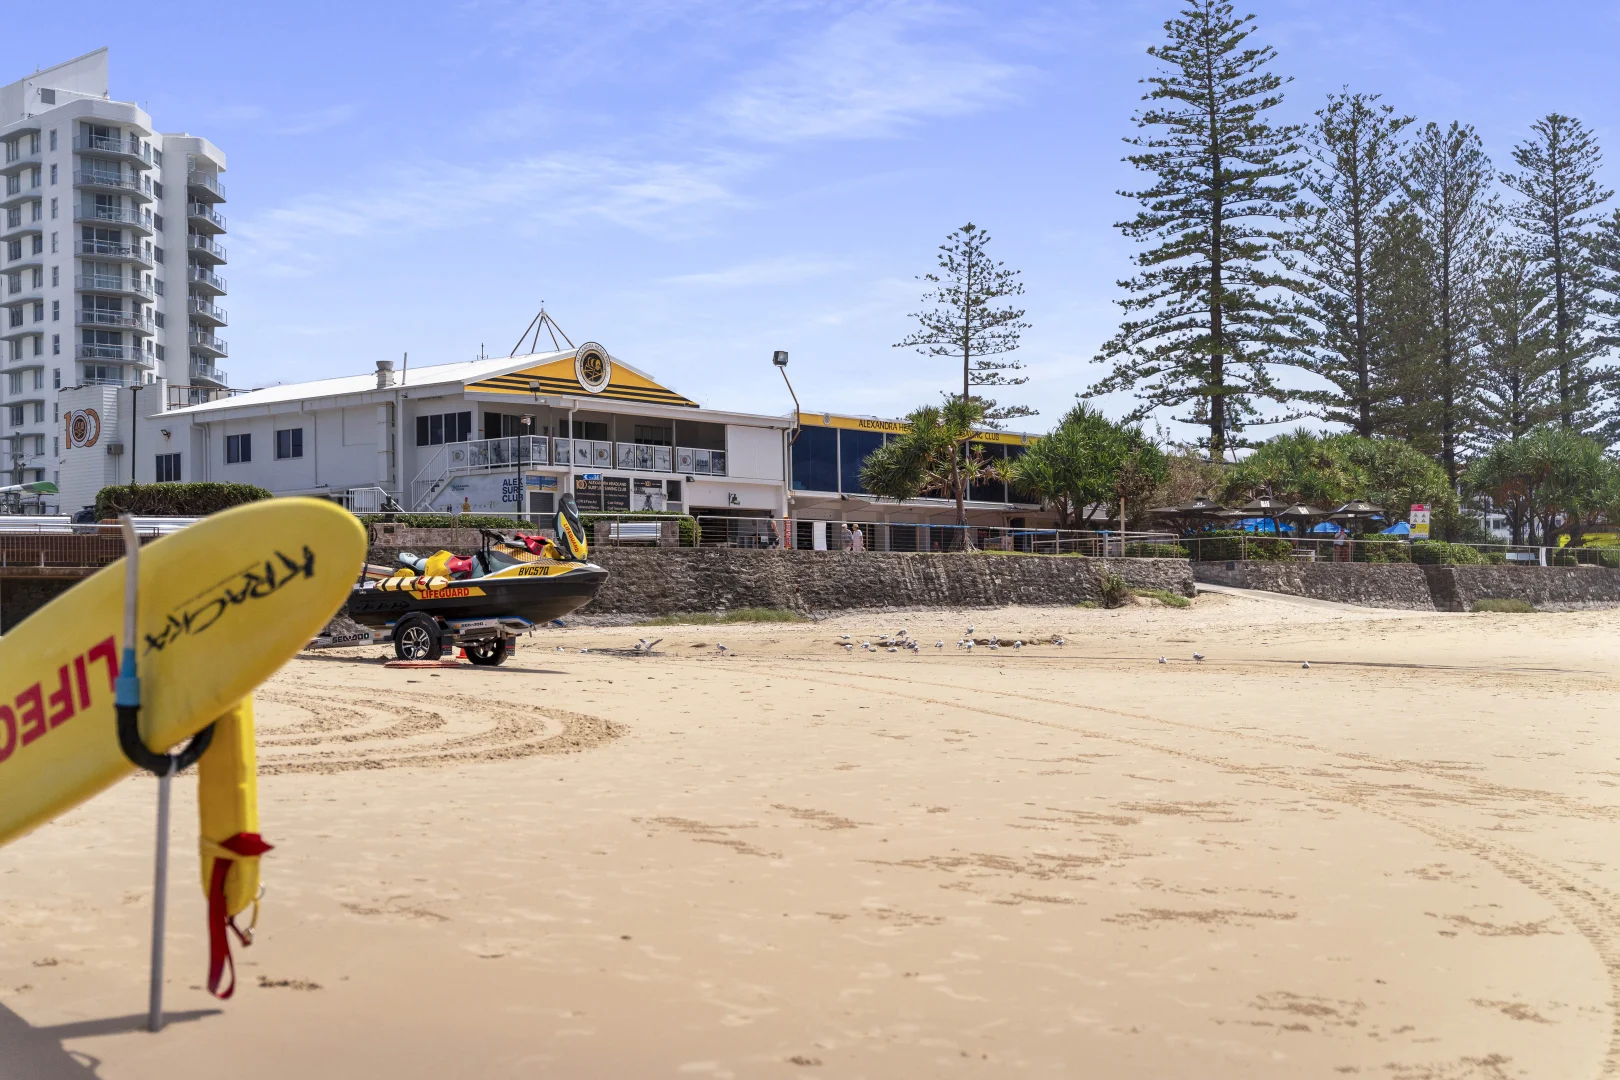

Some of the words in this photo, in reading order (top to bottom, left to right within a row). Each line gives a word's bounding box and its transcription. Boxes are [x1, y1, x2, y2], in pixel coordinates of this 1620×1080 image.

[858, 419, 898, 431] ALEXANDRA
[985, 432, 1000, 441] CLUB
[502, 478, 523, 487] ALEX
[502, 493, 524, 503] CLUB
[563, 523, 579, 553] LIFEGUARD
[143, 544, 316, 656] KRACKA
[420, 587, 470, 599] LIFEGUARD
